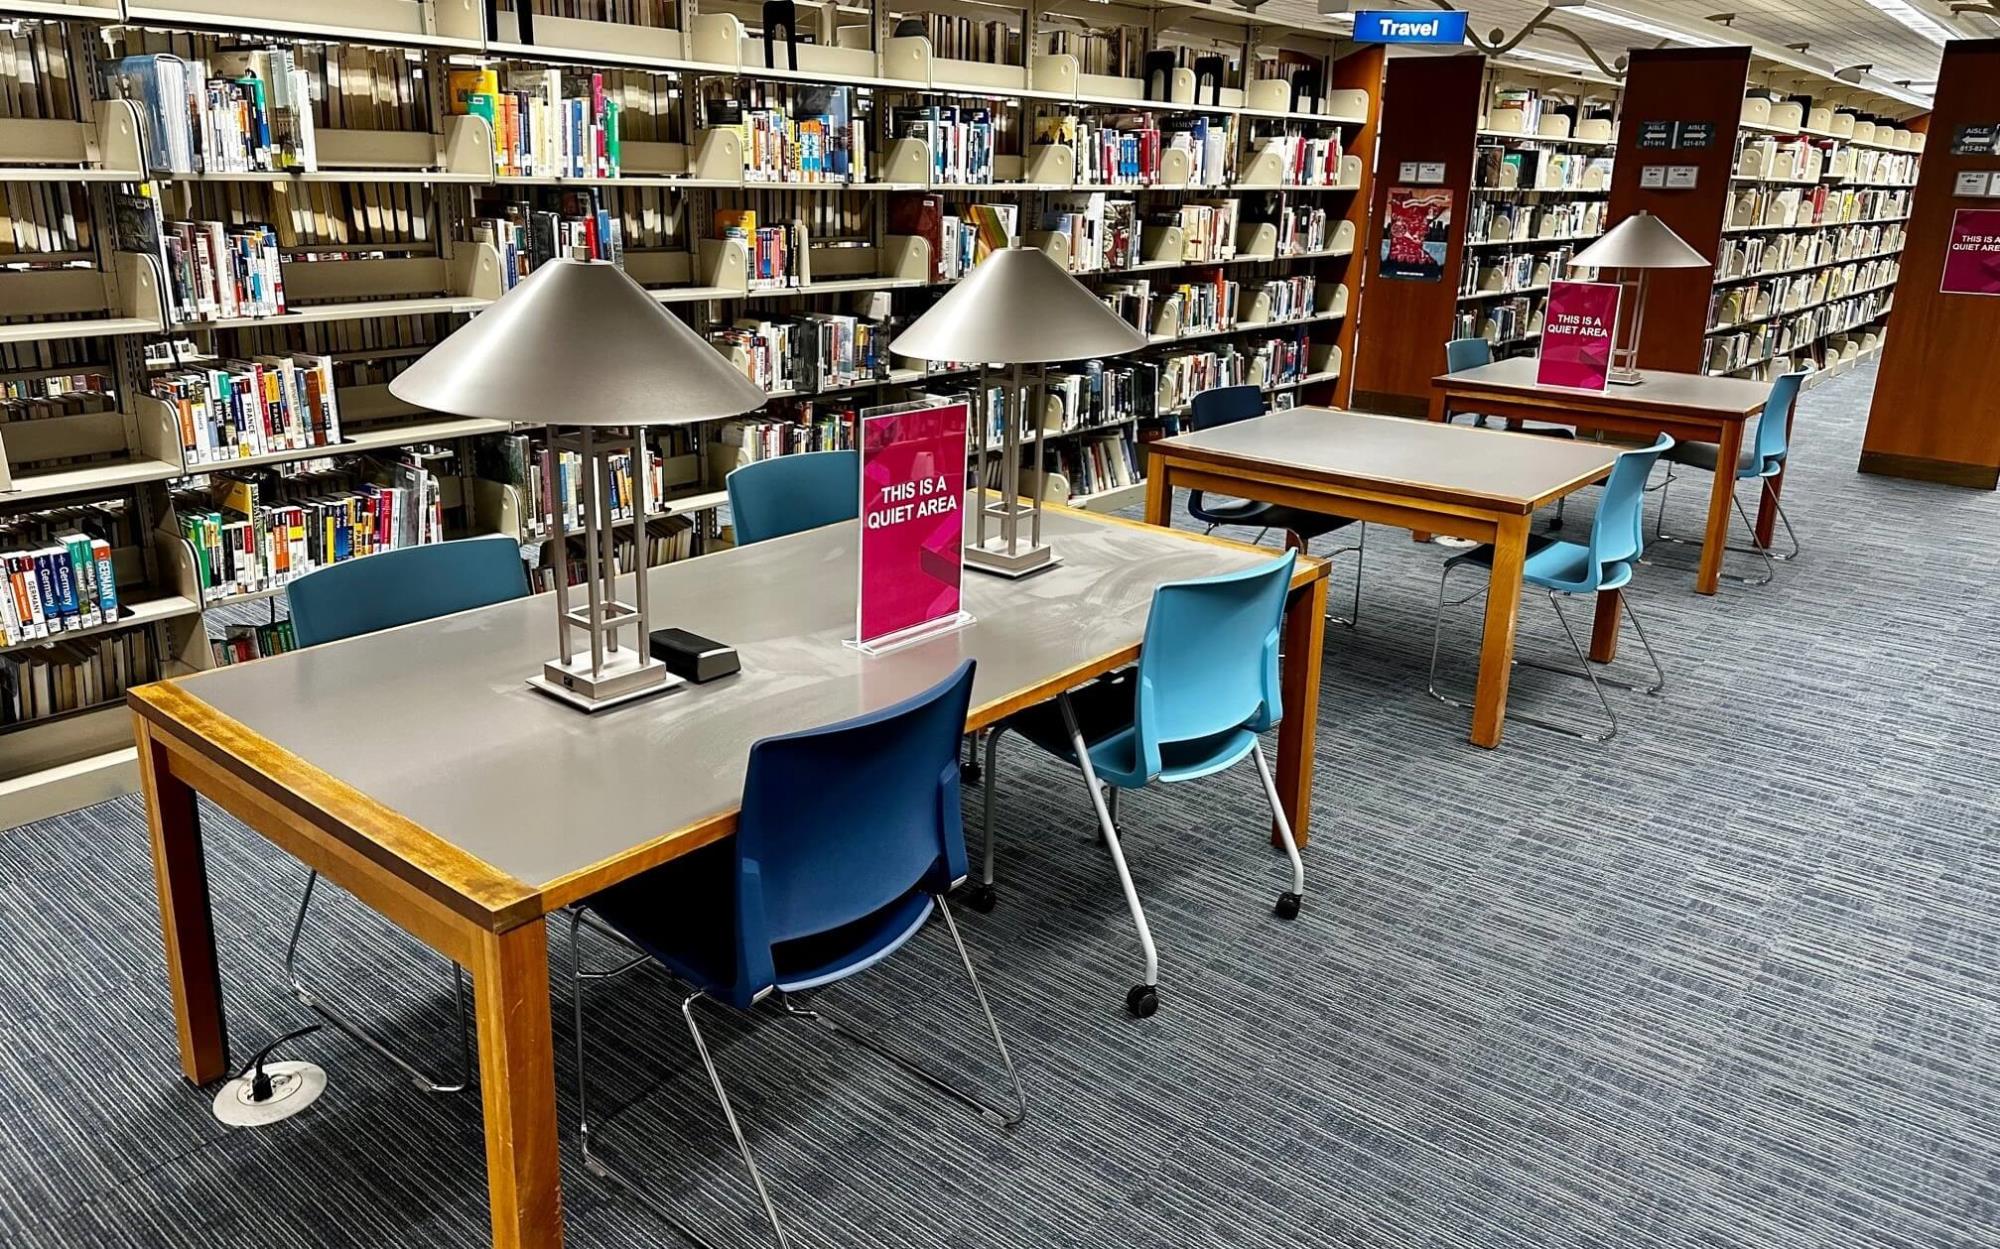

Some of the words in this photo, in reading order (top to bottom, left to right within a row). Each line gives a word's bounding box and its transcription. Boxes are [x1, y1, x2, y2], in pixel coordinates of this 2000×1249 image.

[1379, 19, 1439, 36] Travel
[1952, 243, 1979, 251] QUIET
[1961, 235, 1982, 243] THIS
[1547, 324, 1579, 335] QUIET
[1579, 327, 1608, 338] AREA
[1557, 314, 1580, 325] THIS
[1582, 315, 1592, 325] IS
[1594, 317, 1601, 327] A
[214, 401, 224, 427] FRANCE
[244, 402, 256, 435] FRANCE
[272, 404, 281, 432] FRANCE
[322, 402, 331, 428] FRANCE
[881, 480, 916, 504] THIS
[919, 478, 935, 497] IS
[935, 475, 947, 492] A
[867, 503, 915, 530] QUIET
[916, 494, 958, 519] AREA
[41, 568, 55, 607] Germany
[60, 566, 73, 606] Germany
[98, 560, 114, 600] GERMANY
[28, 580, 41, 614] GERMANY
